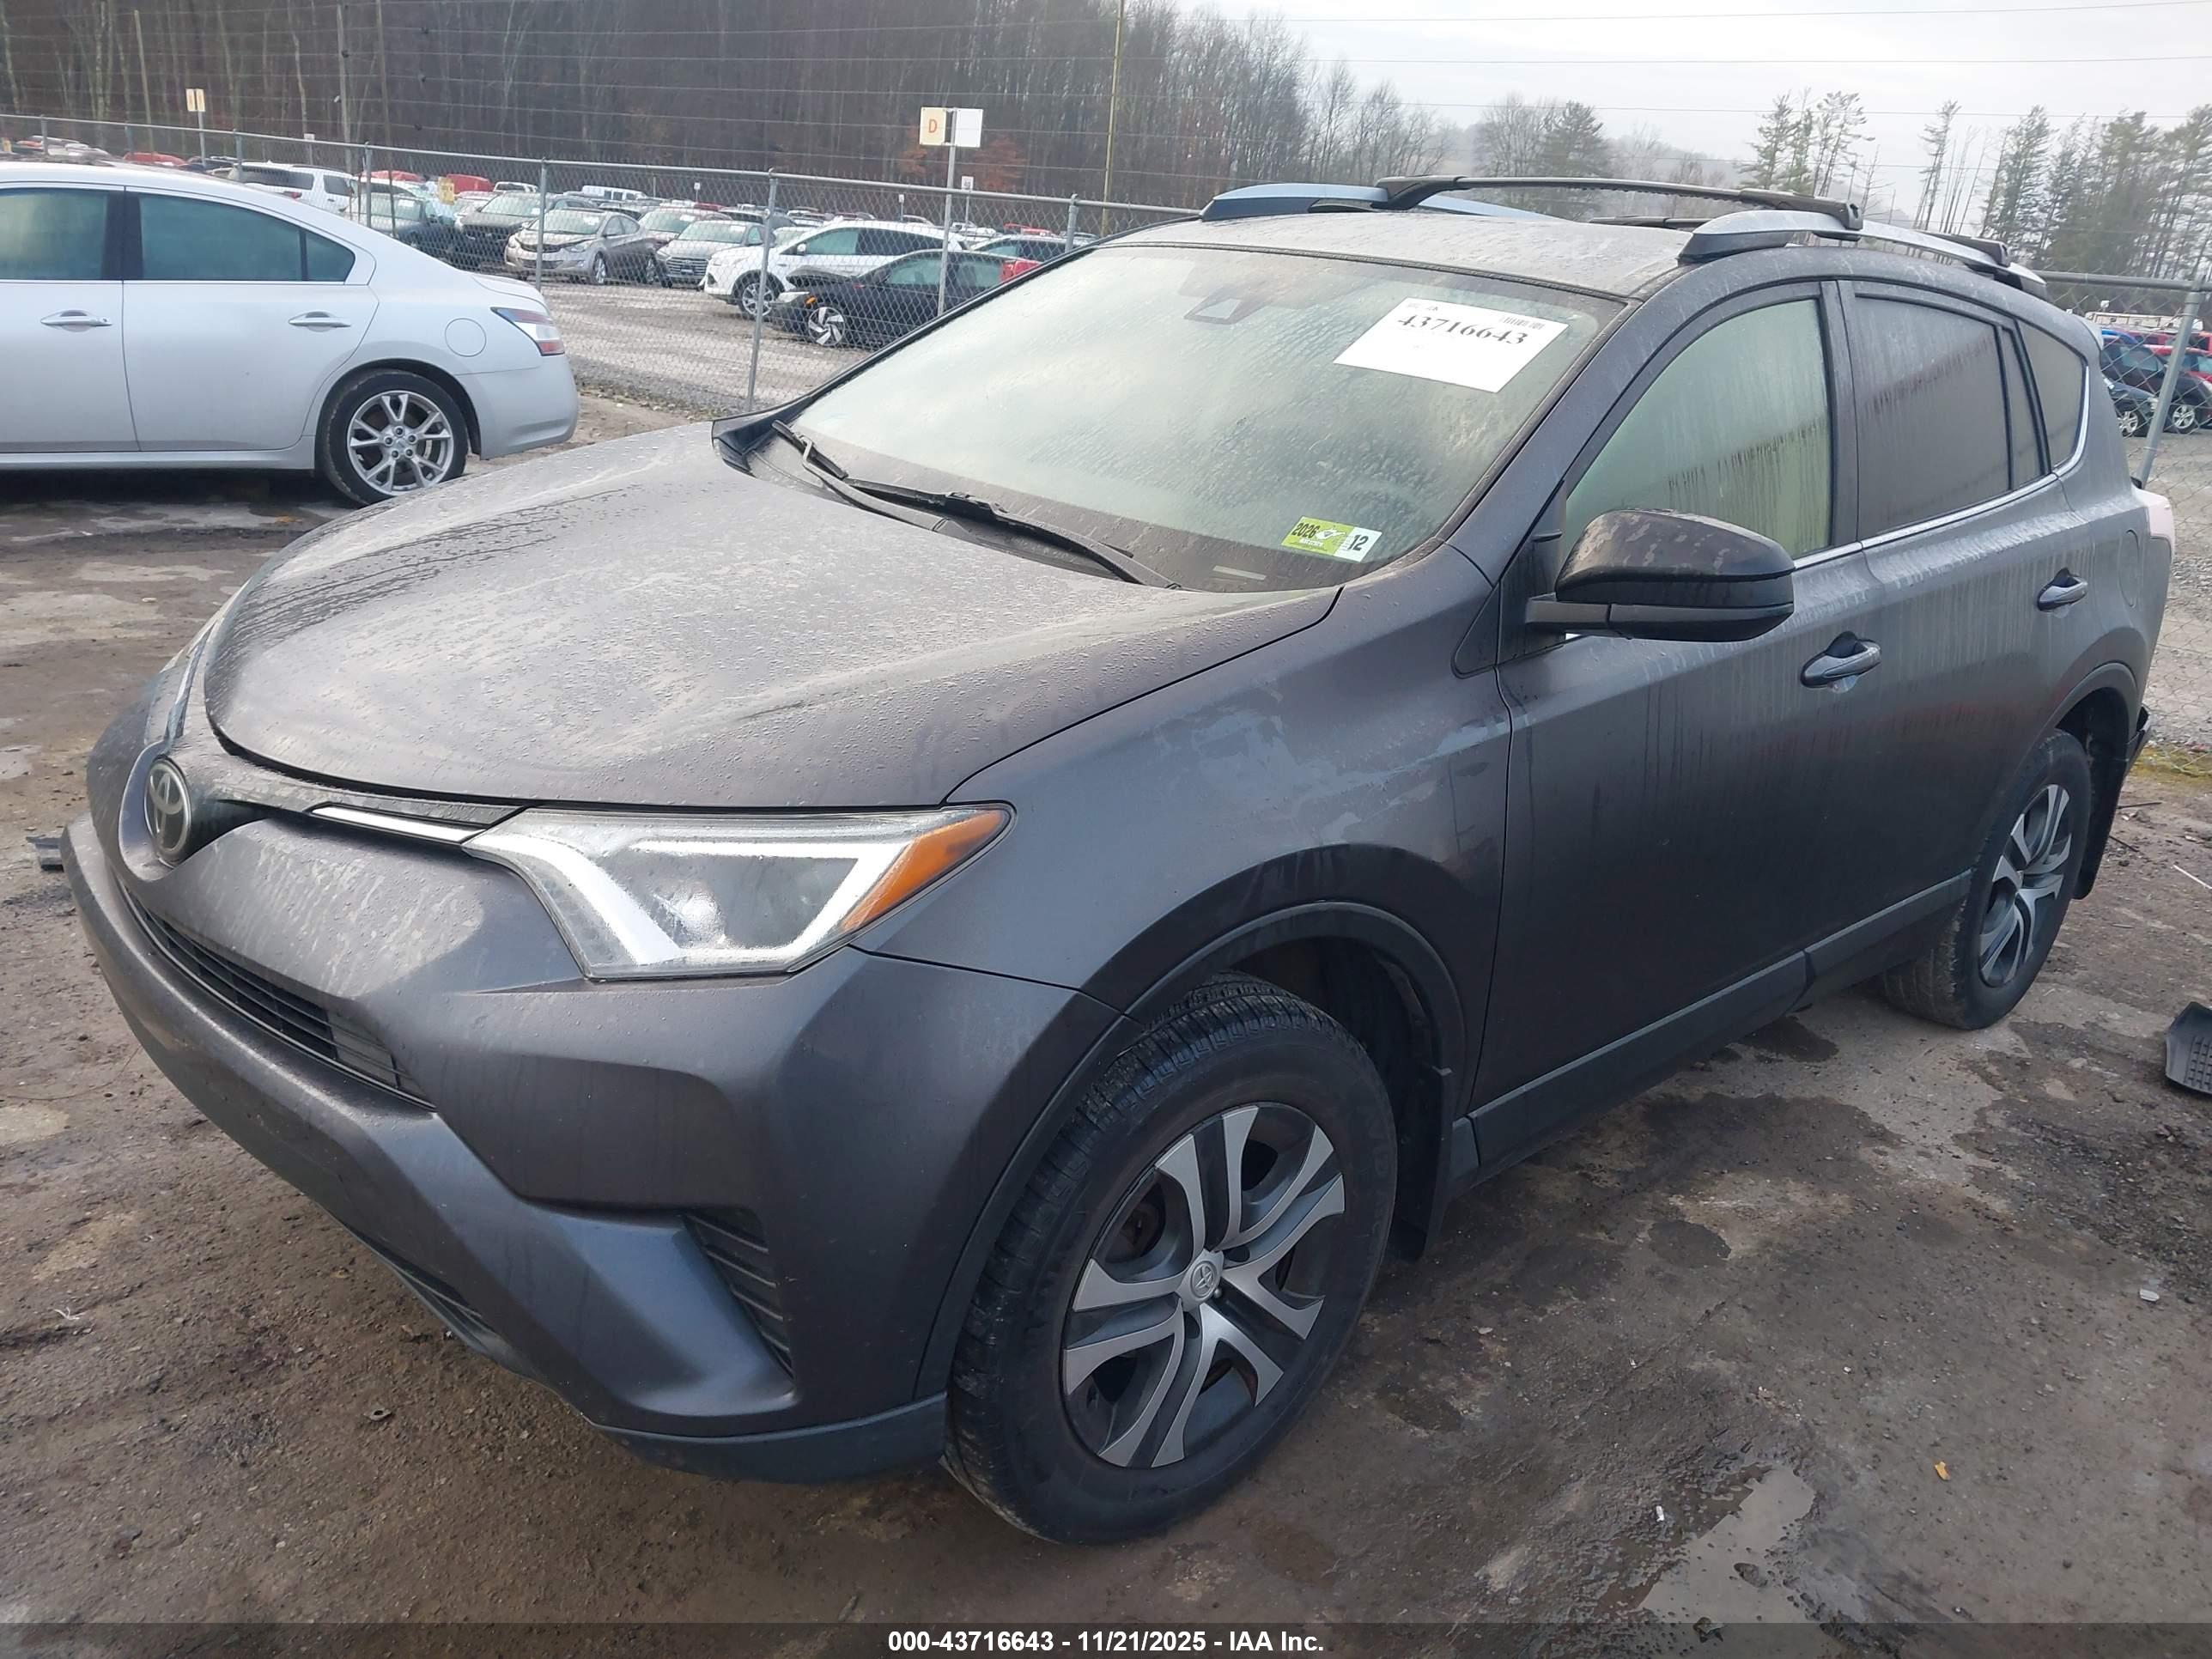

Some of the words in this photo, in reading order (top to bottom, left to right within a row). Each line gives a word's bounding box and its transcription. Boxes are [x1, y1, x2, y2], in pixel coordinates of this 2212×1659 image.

[928, 118, 938, 134] D
[1397, 314, 1529, 345] 43716643
[1291, 522, 1321, 539] 2026
[1347, 534, 1369, 551] 12
